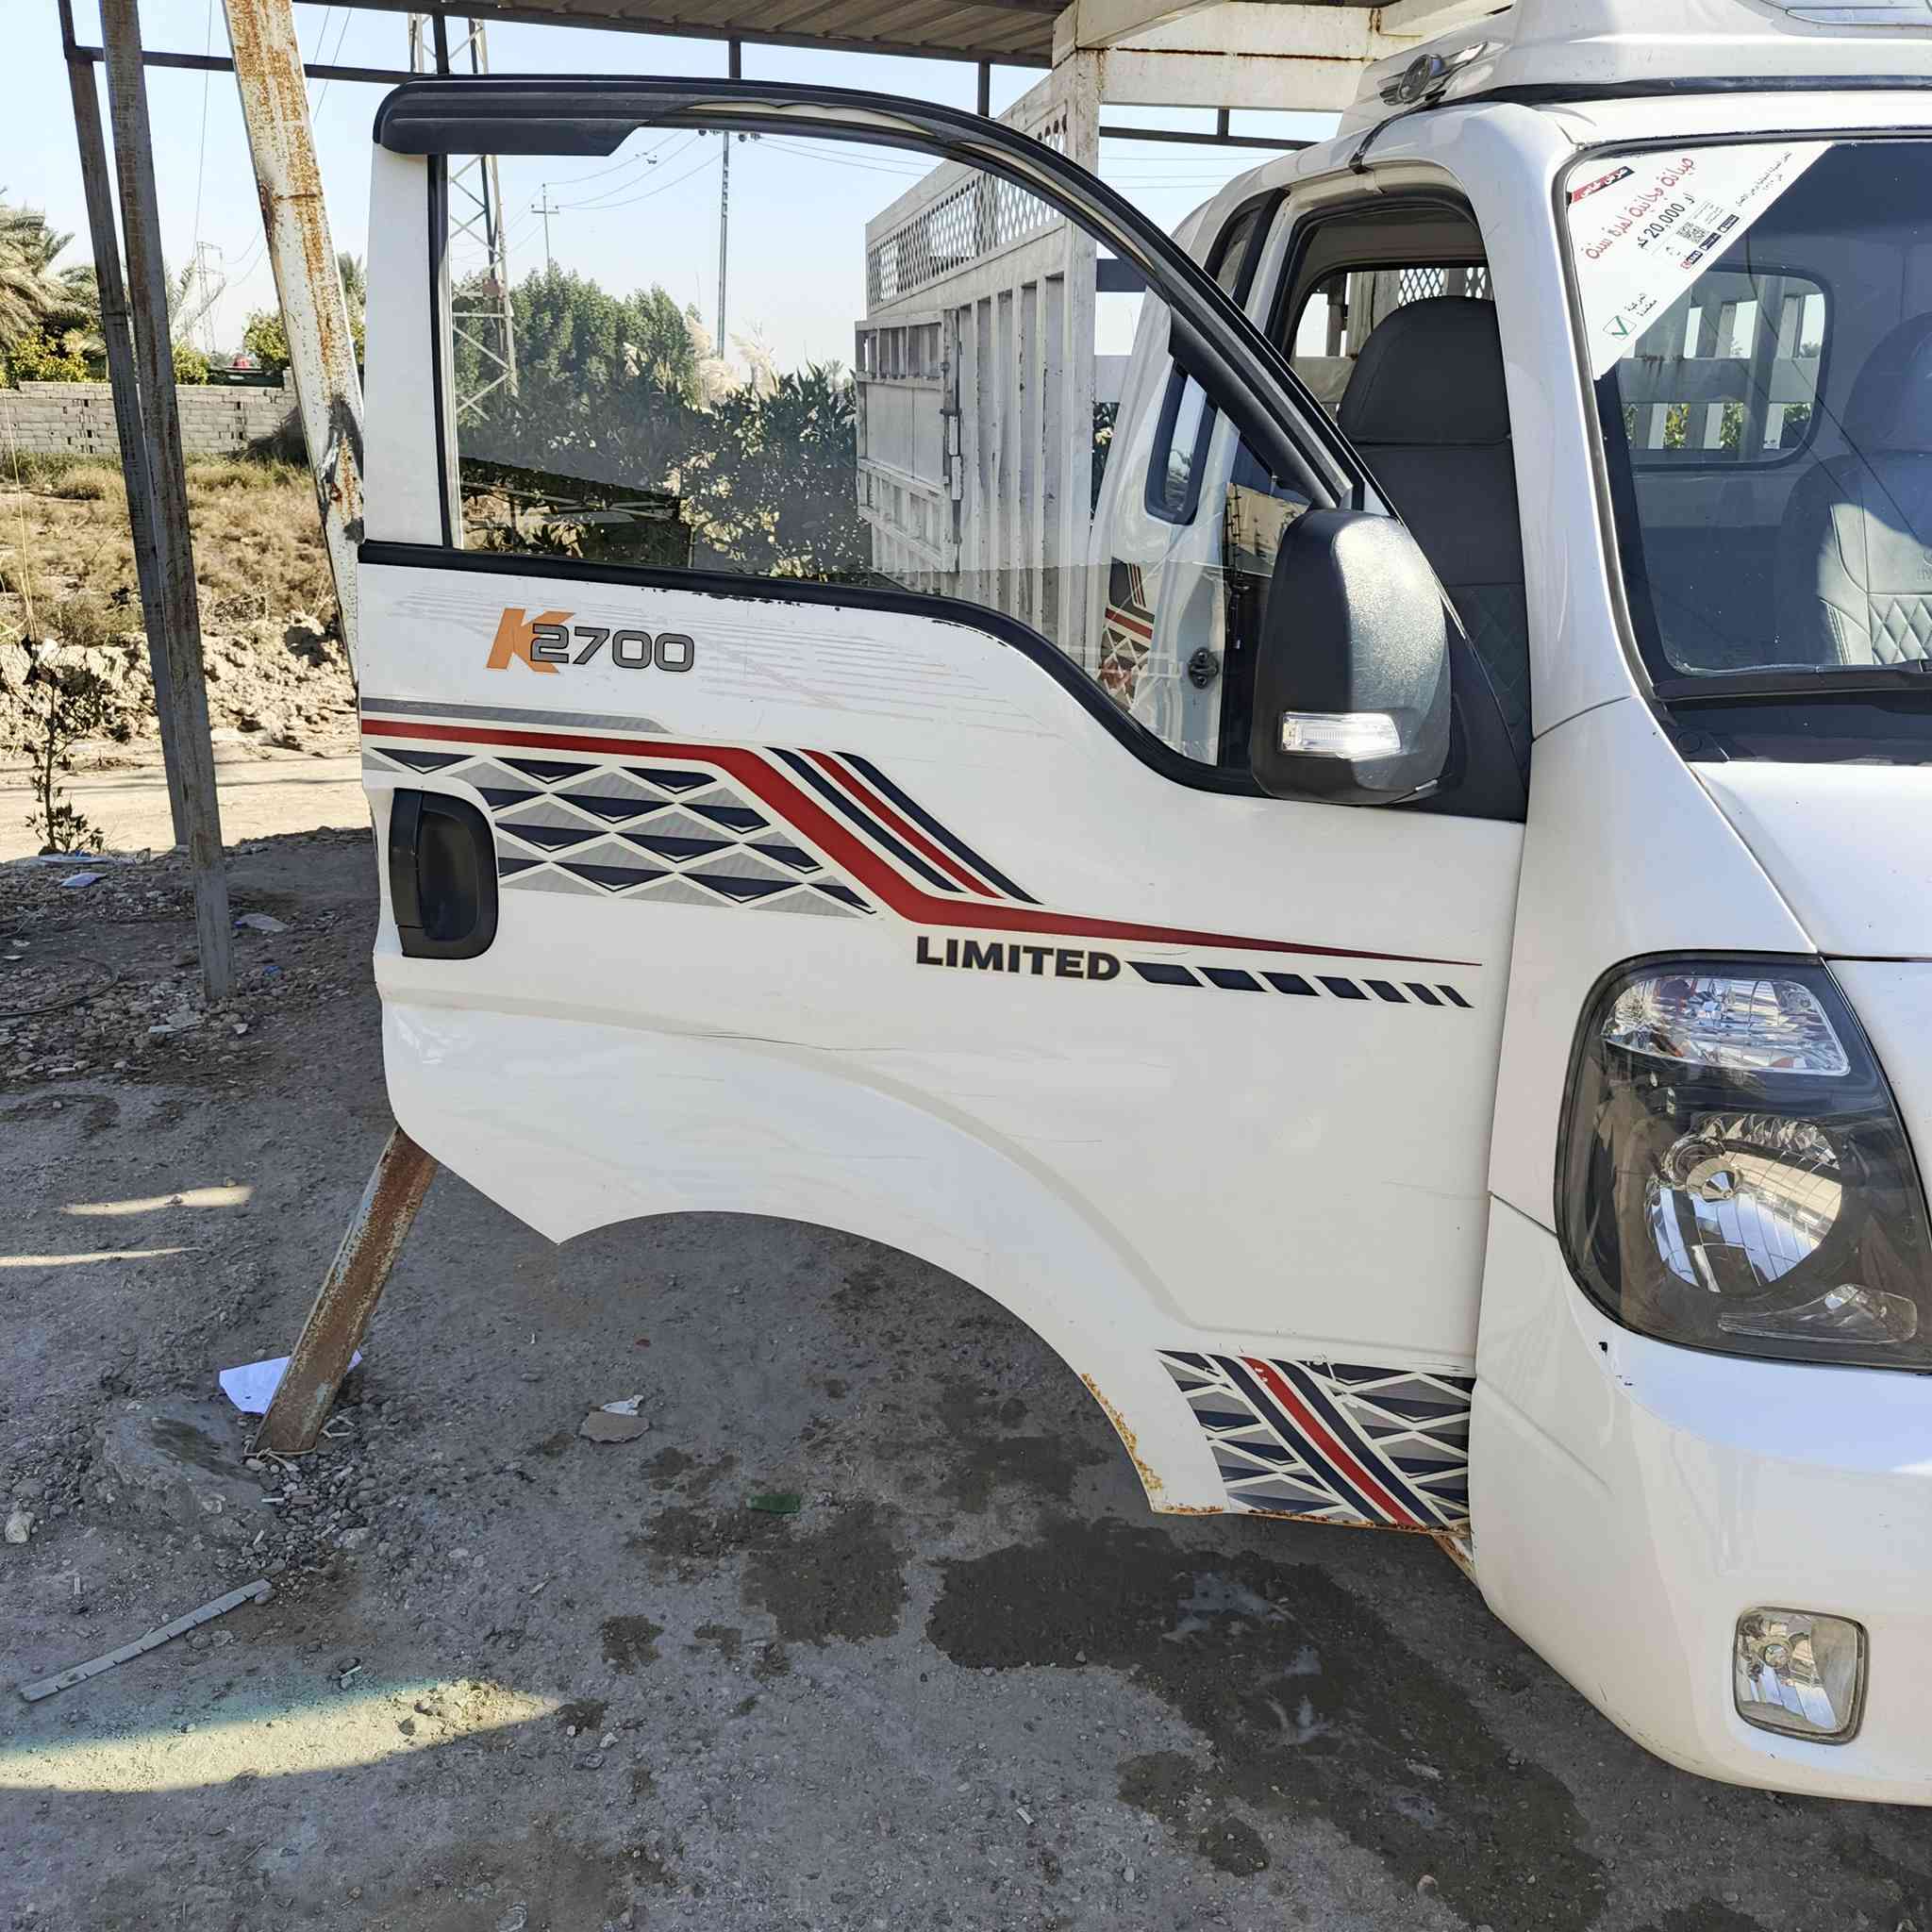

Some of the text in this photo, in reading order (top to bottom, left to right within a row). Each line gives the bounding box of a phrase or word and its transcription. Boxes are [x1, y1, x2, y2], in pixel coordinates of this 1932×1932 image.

[1656, 158, 1696, 188] صيانة
[1624, 187, 1667, 218] مجانية
[1602, 214, 1634, 238] لمدة
[1644, 202, 1686, 240] 20,000
[1581, 238, 1613, 260] سنة
[486, 608, 694, 674] K2700
[916, 936, 1121, 980] LIMITED
